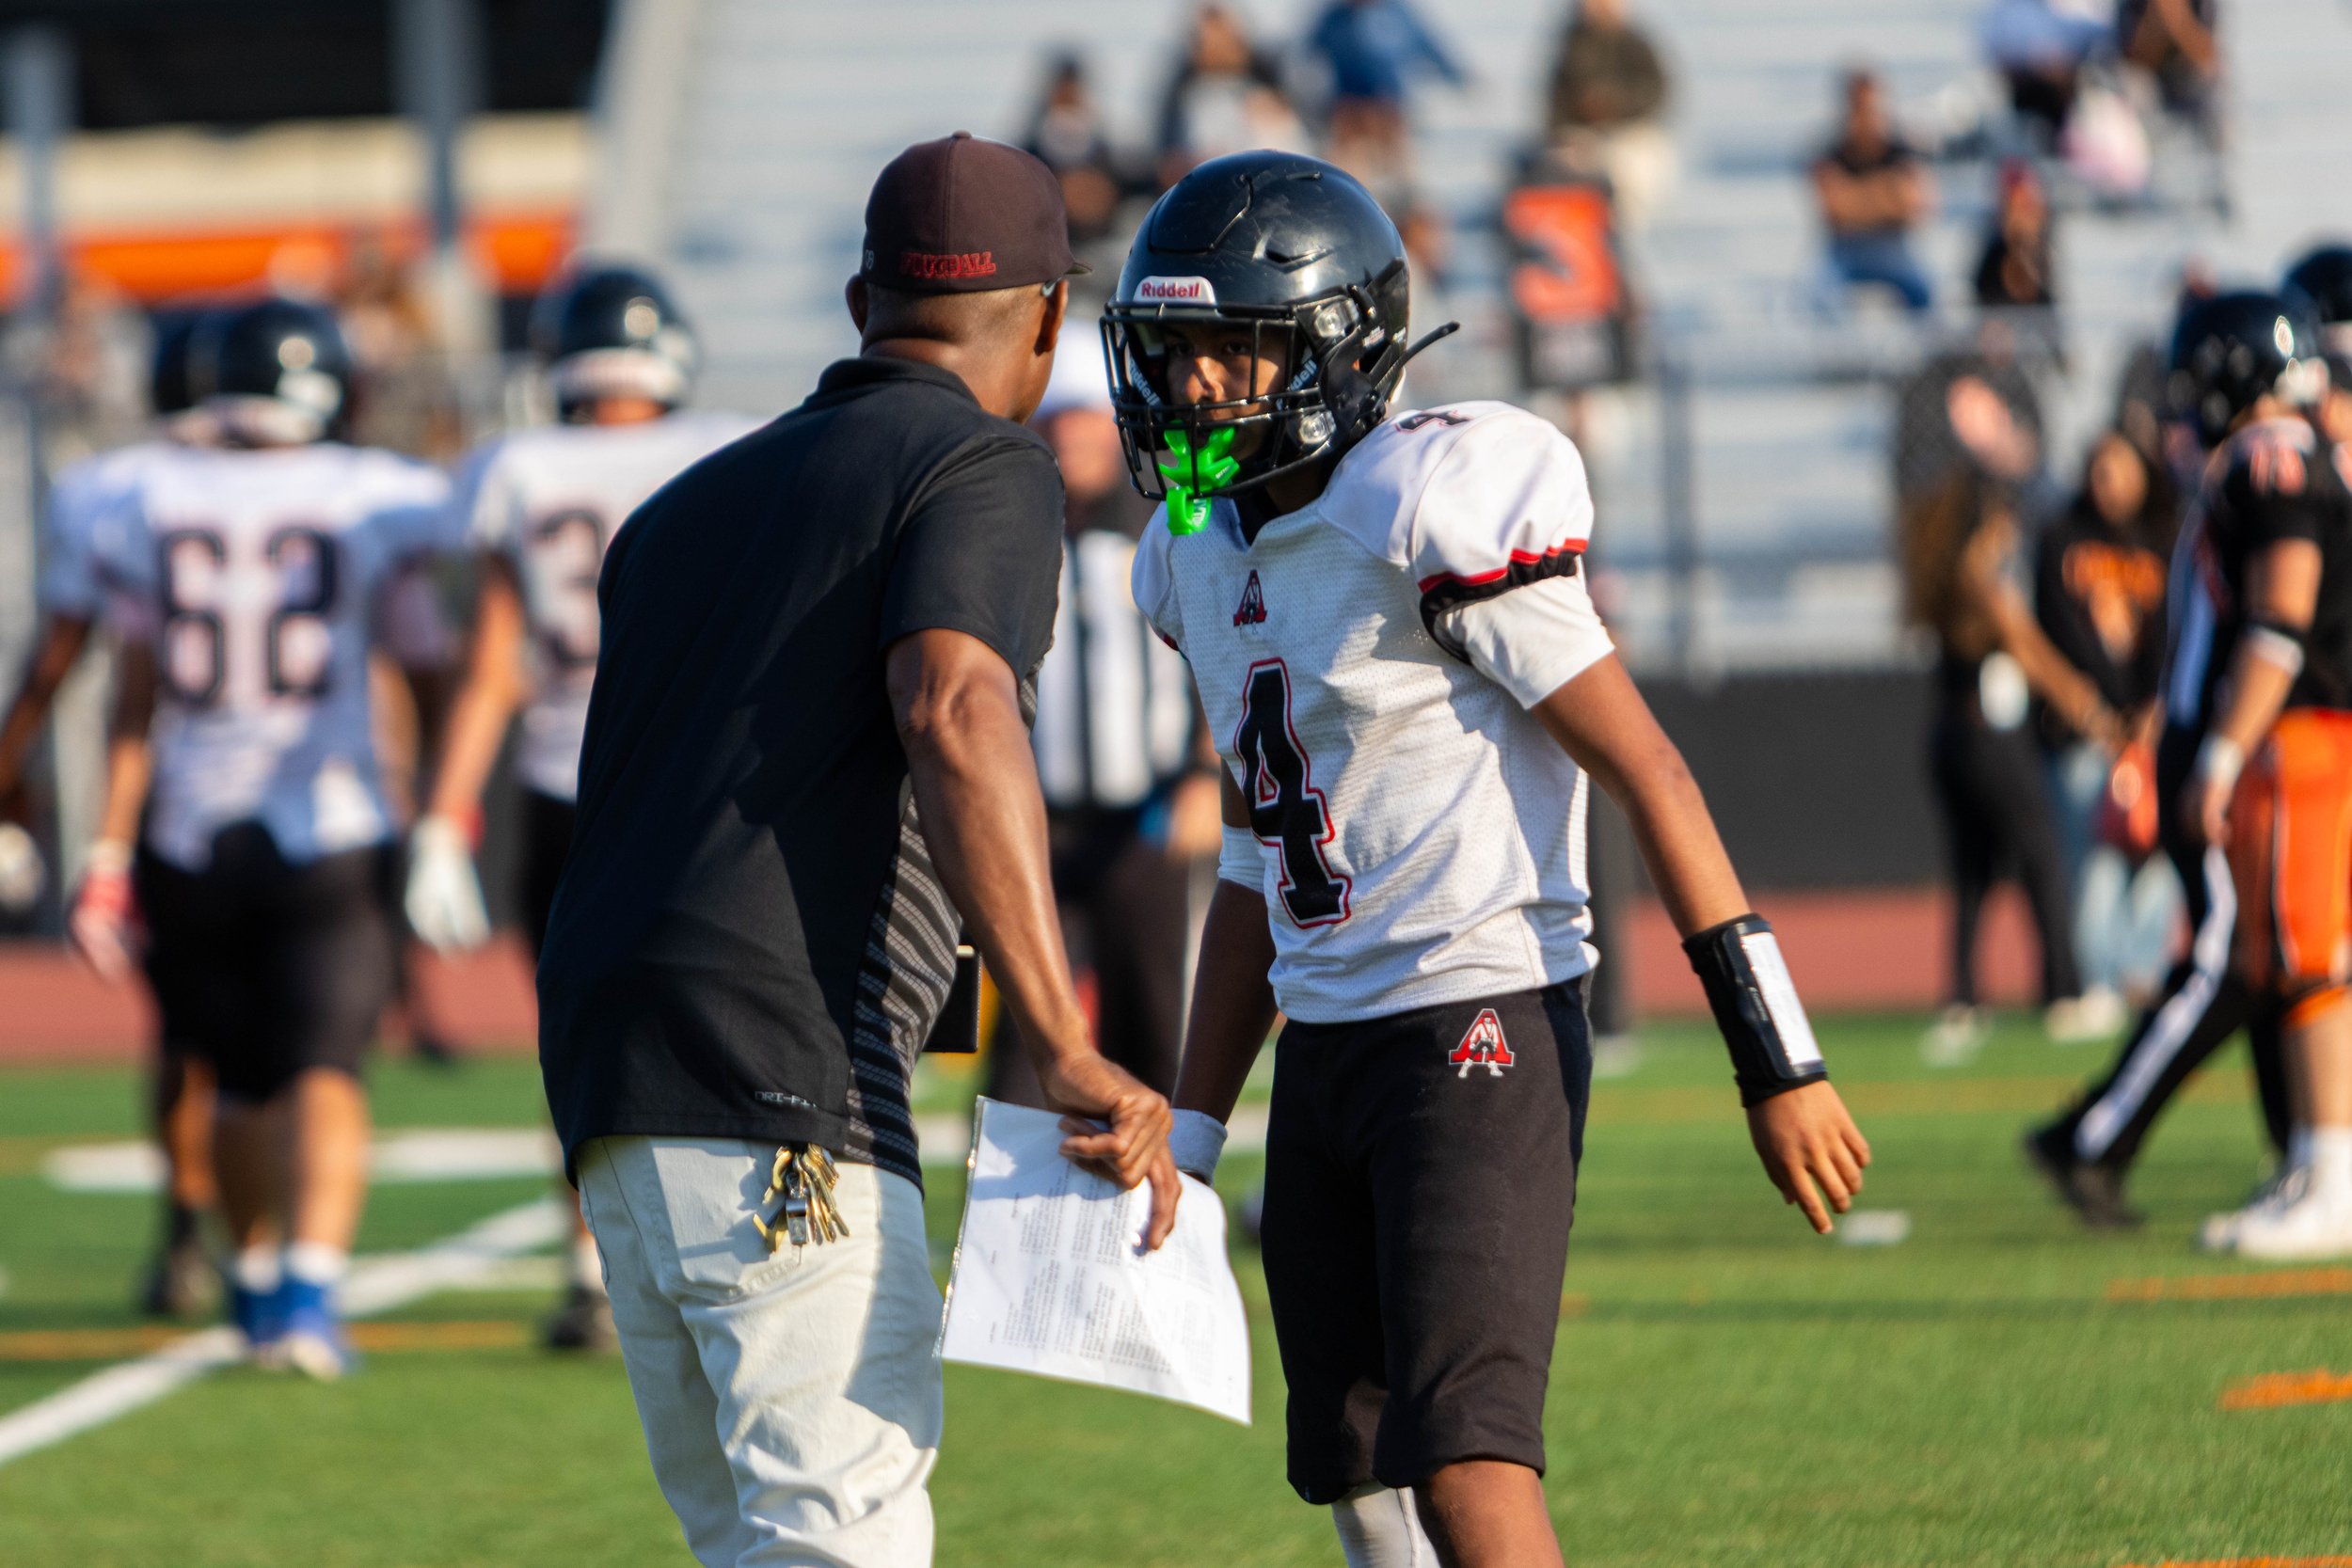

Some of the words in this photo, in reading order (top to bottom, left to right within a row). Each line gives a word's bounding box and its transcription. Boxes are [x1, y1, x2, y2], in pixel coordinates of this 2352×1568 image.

[1141, 283, 1200, 297] Riddell
[159, 527, 337, 708] 62
[1233, 657, 1352, 929] 4
